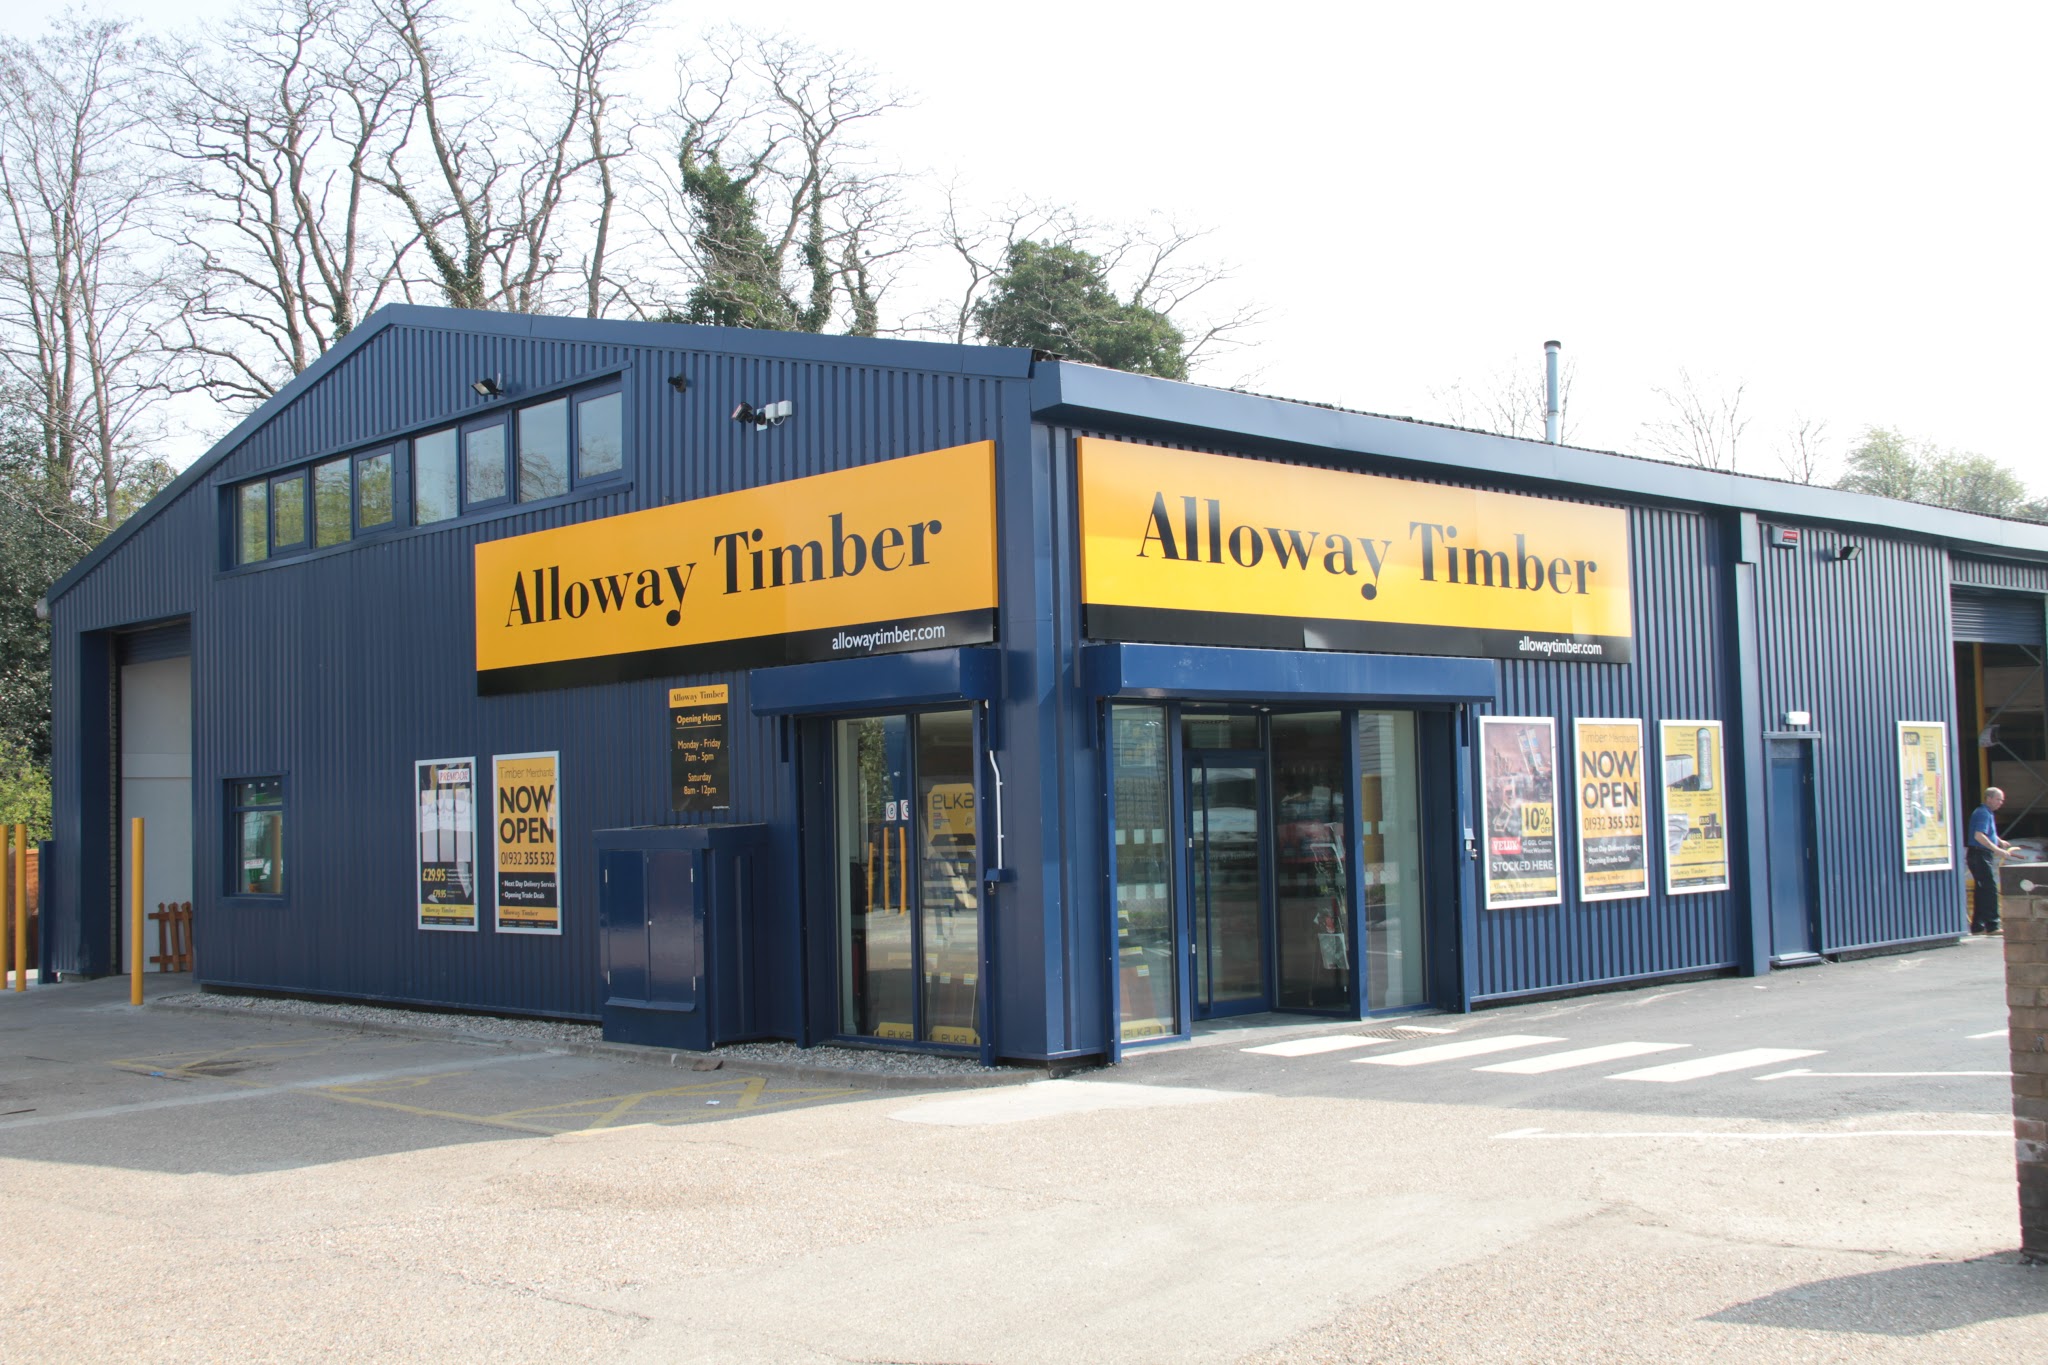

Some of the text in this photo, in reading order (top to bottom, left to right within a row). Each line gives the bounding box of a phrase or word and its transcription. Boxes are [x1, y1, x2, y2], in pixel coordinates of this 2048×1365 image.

[1136, 491, 1598, 601] Alloway Timber
[505, 512, 943, 627] Alloway Timber
[831, 623, 946, 652] allowaytimber.com
[1518, 636, 1603, 657] allowaytimber.com
[673, 690, 725, 703] Alloway Timber
[676, 713, 722, 725] Opening Hours
[1580, 730, 1608, 744] Timber
[677, 740, 700, 751] Monday
[703, 738, 721, 750] Friday
[684, 752, 697, 762] 7am
[701, 751, 715, 763] 5pm
[1581, 750, 1638, 779] NOW
[500, 767, 555, 779] Timber Merchants
[687, 772, 712, 784] Saturday
[683, 785, 696, 795] 8am
[701, 784, 717, 797] 12pm
[1583, 781, 1639, 810] OPEN
[500, 784, 555, 814] NOW
[1525, 806, 1550, 831] 10%
[1584, 815, 1640, 831] 01932 355 532
[500, 817, 554, 844] OPEN
[1540, 826, 1552, 834] OFF
[1493, 840, 1519, 851] VELUX
[500, 851, 555, 866] 01932 355 532
[1492, 859, 1554, 873] STOCKED HERE
[422, 867, 446, 882] £29.95
[515, 880, 523, 889] Day
[523, 880, 540, 889] Delivery
[504, 891, 521, 900] Opening
[521, 891, 533, 899] Trade
